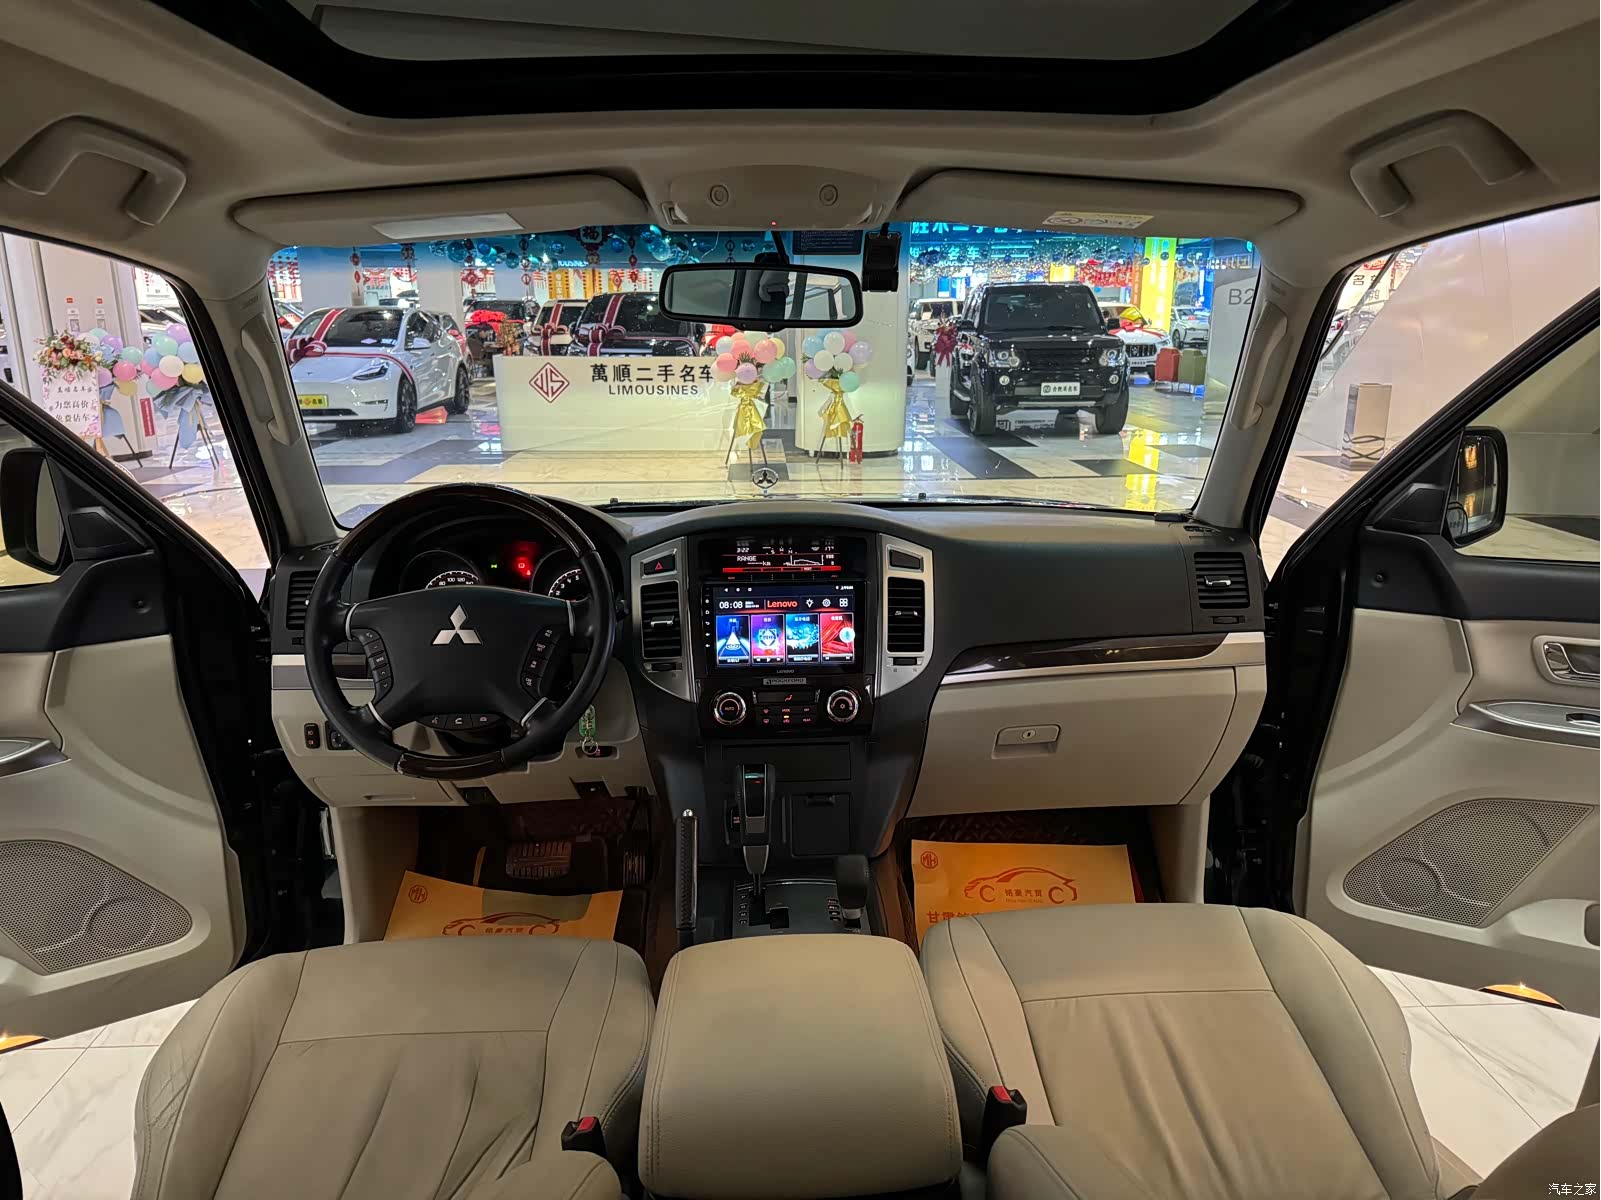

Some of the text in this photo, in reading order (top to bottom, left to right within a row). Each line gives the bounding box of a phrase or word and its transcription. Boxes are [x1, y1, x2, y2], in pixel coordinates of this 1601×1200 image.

[1228, 288, 1255, 305] B2
[590, 364, 713, 382] 萬順二手名车
[608, 384, 699, 396] LIMOUSINES
[719, 601, 743, 609] 08:08
[767, 600, 798, 608] Lenovo
